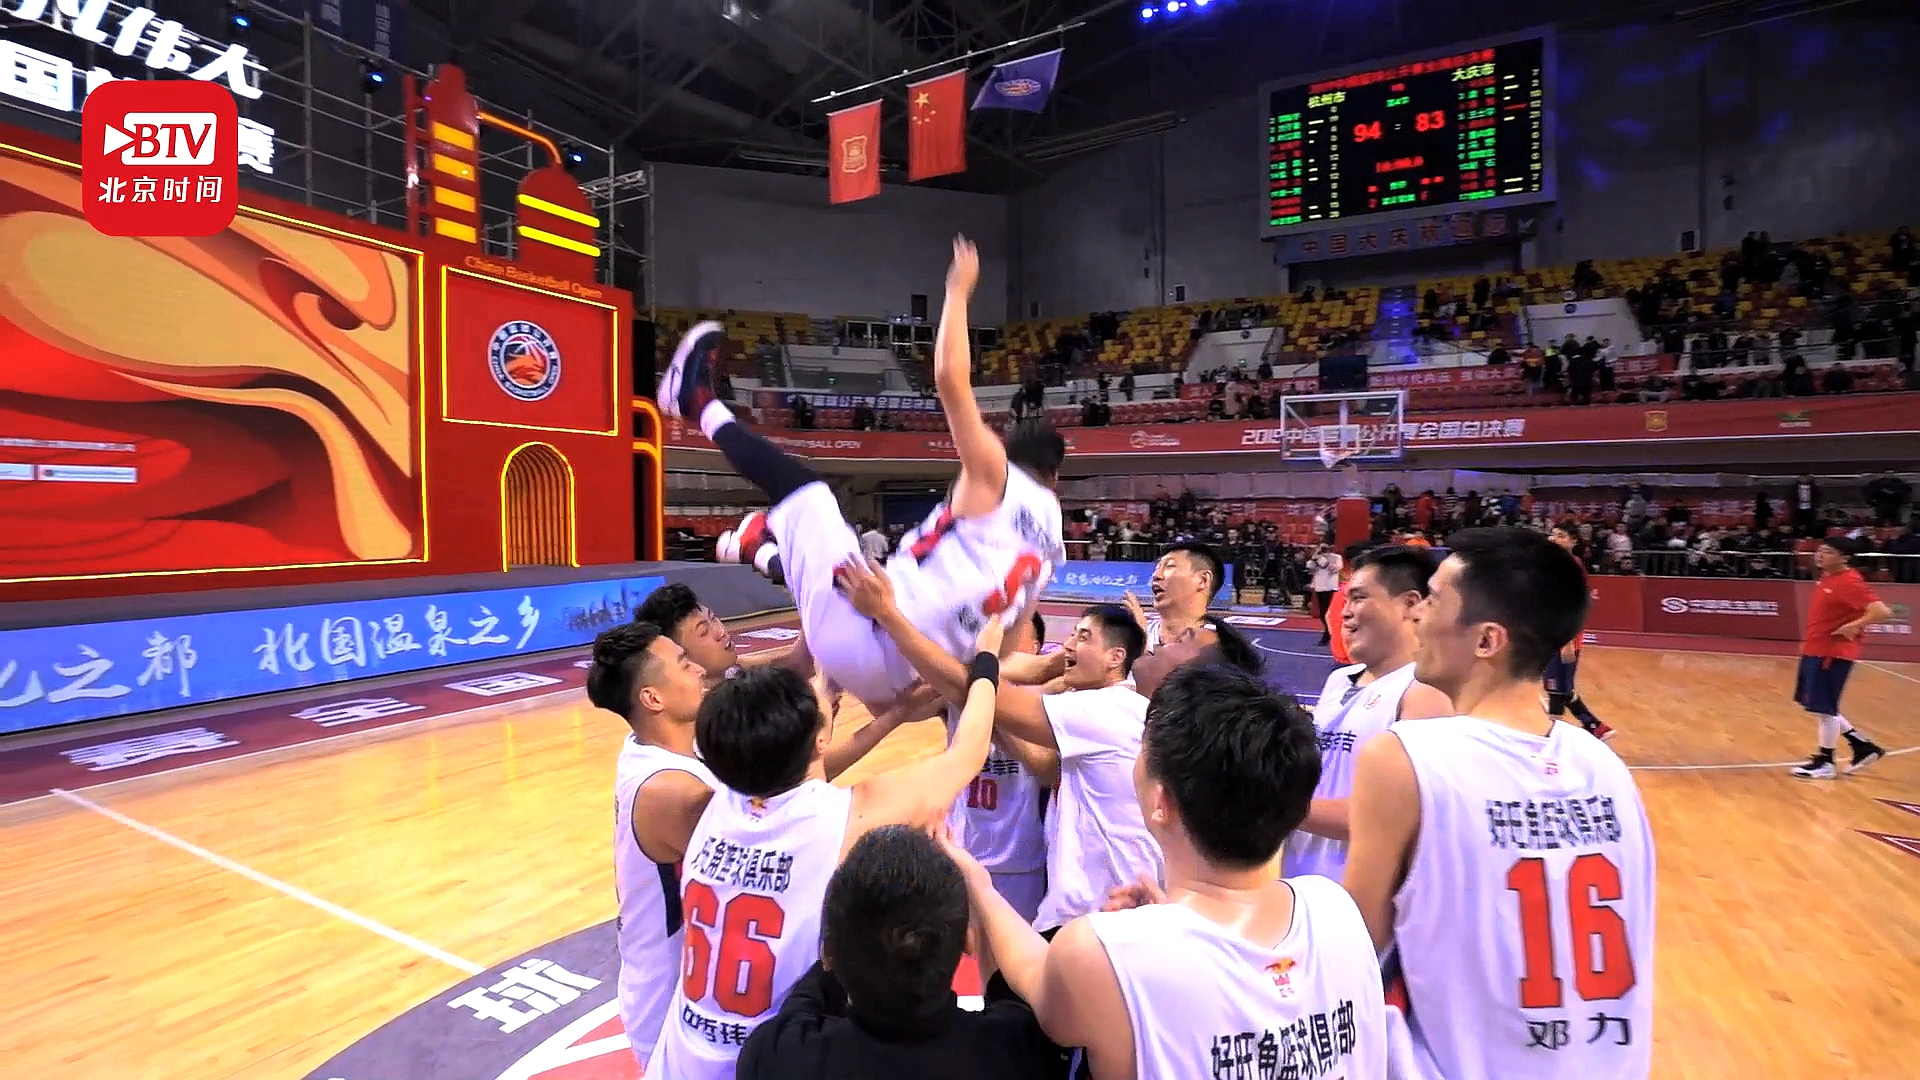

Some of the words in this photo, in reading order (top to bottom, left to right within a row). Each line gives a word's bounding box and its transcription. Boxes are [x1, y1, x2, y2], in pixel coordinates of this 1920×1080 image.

[1353, 120, 1382, 142] 94
[1416, 110, 1445, 132] 83
[252, 595, 541, 676] 北国温泉之乡
[682, 878, 785, 1018] 66
[1505, 852, 1636, 1009] 16
[1525, 1011, 1633, 1051] 邓力
